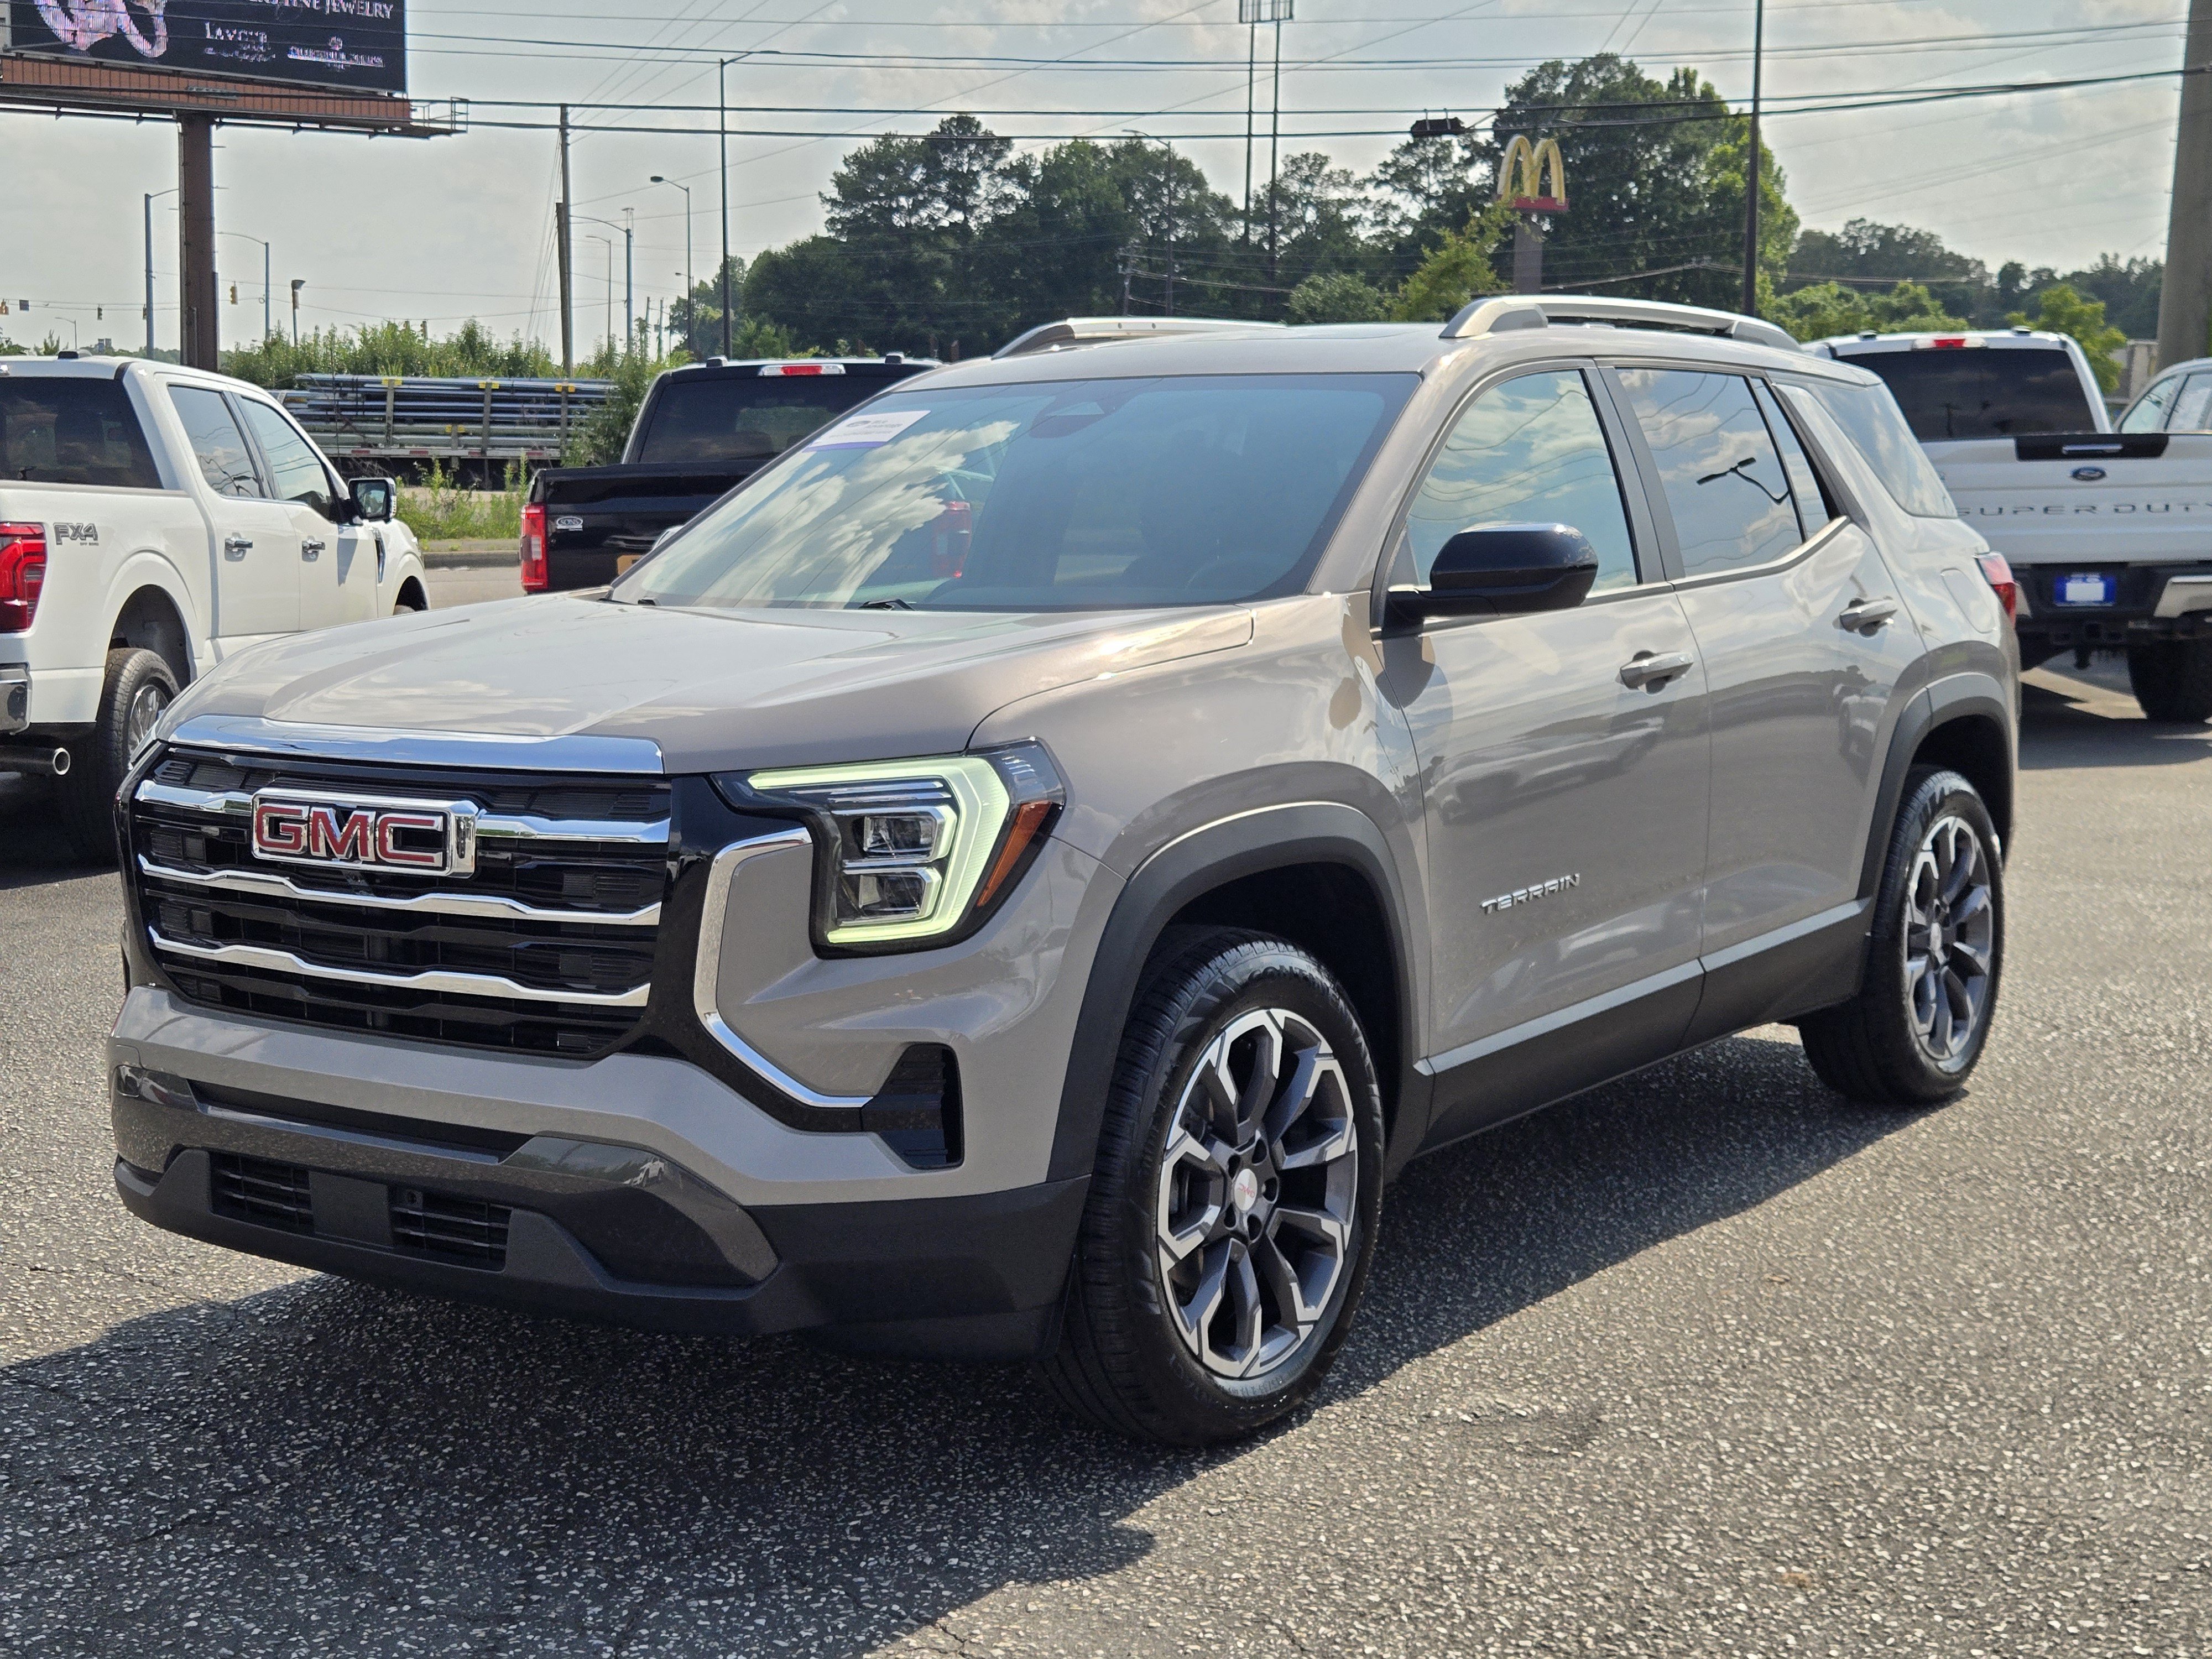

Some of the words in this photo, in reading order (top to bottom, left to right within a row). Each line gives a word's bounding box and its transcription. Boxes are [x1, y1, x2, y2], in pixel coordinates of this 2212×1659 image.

[325, 0, 394, 19] JEWELRY
[53, 523, 98, 545] FX4
[255, 803, 443, 867] GMC
[1480, 873, 1580, 914] TERRAIN
